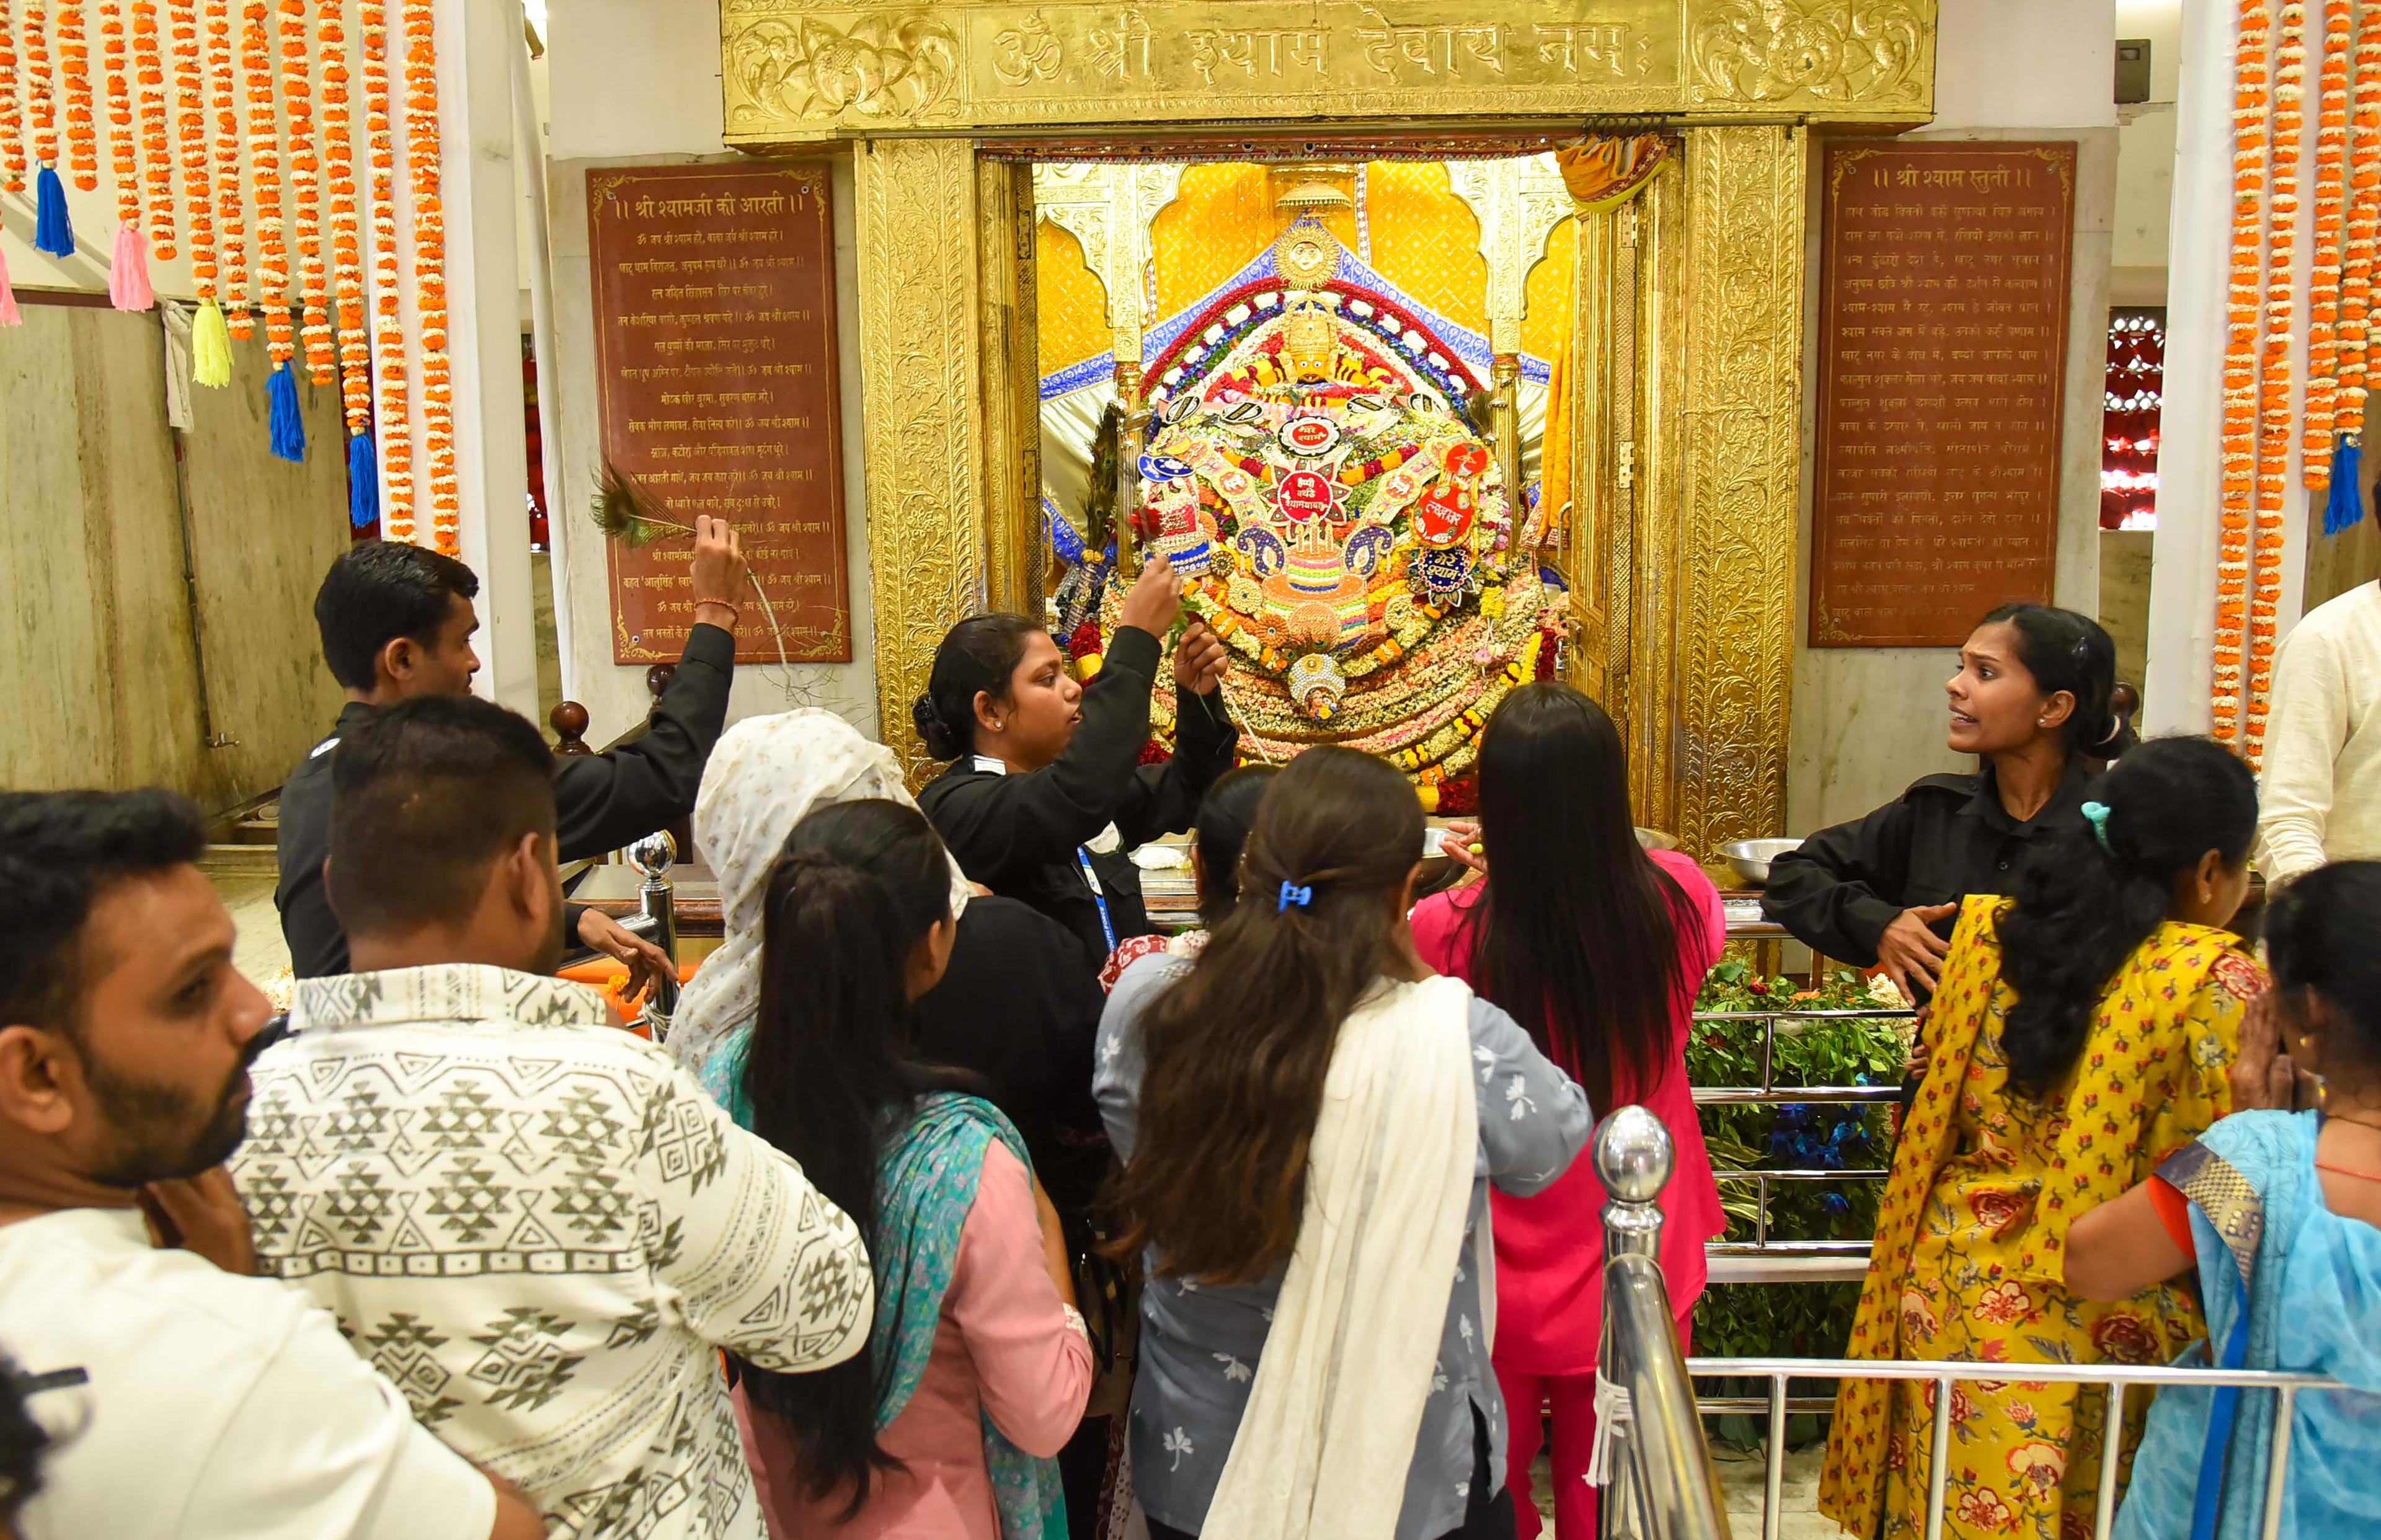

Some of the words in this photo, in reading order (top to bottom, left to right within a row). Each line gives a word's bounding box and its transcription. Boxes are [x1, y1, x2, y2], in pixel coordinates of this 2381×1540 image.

[1085, 9, 1160, 79] श्री
[1354, 5, 1512, 83] देवाय
[1896, 163, 1920, 187] श्री
[1923, 169, 1966, 187] श्याम
[635, 194, 655, 218] श्री
[658, 192, 713, 218] श्यामजी
[716, 192, 736, 217] की
[740, 190, 784, 216] आरती
[1434, 551, 1458, 567] मेरे
[1427, 565, 1458, 580] श्याम
